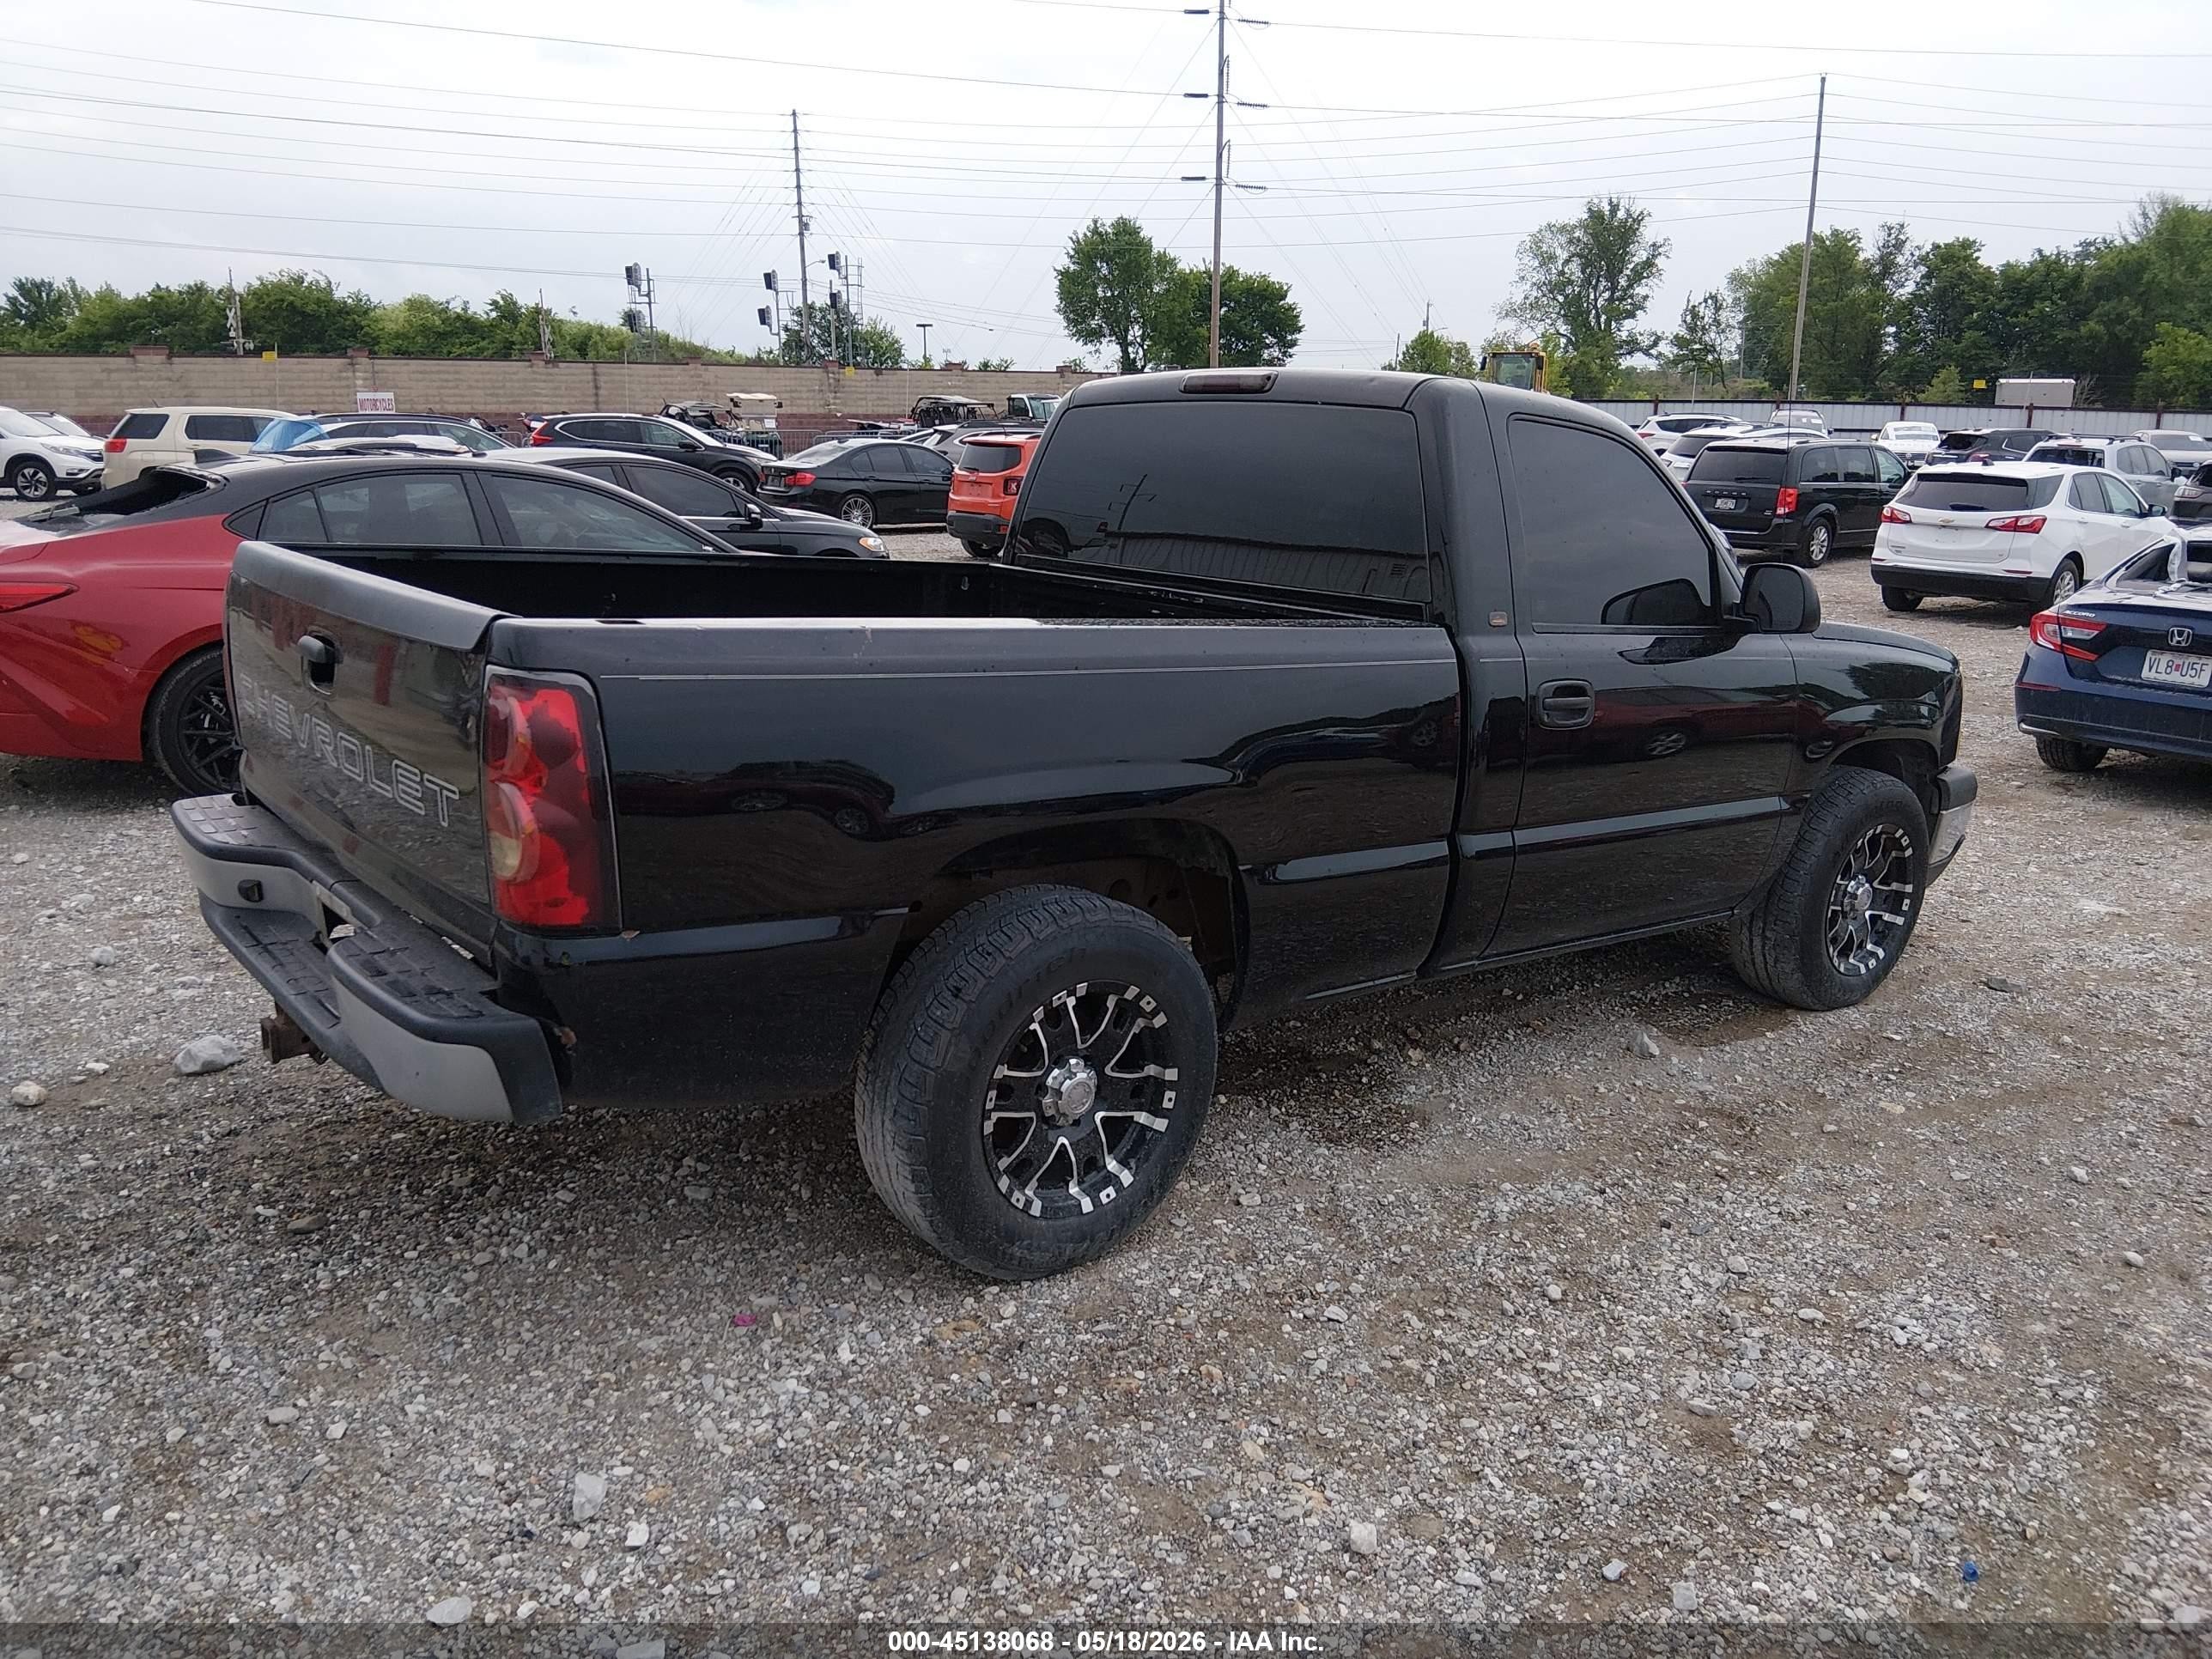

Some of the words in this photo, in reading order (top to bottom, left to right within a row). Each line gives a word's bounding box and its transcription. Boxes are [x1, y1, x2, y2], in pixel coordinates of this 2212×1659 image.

[358, 398, 394, 411] MOTORCYCLES
[2148, 656, 2174, 675] VL8
[2179, 660, 2209, 679] U5F
[240, 672, 460, 827] CHEVROLET
